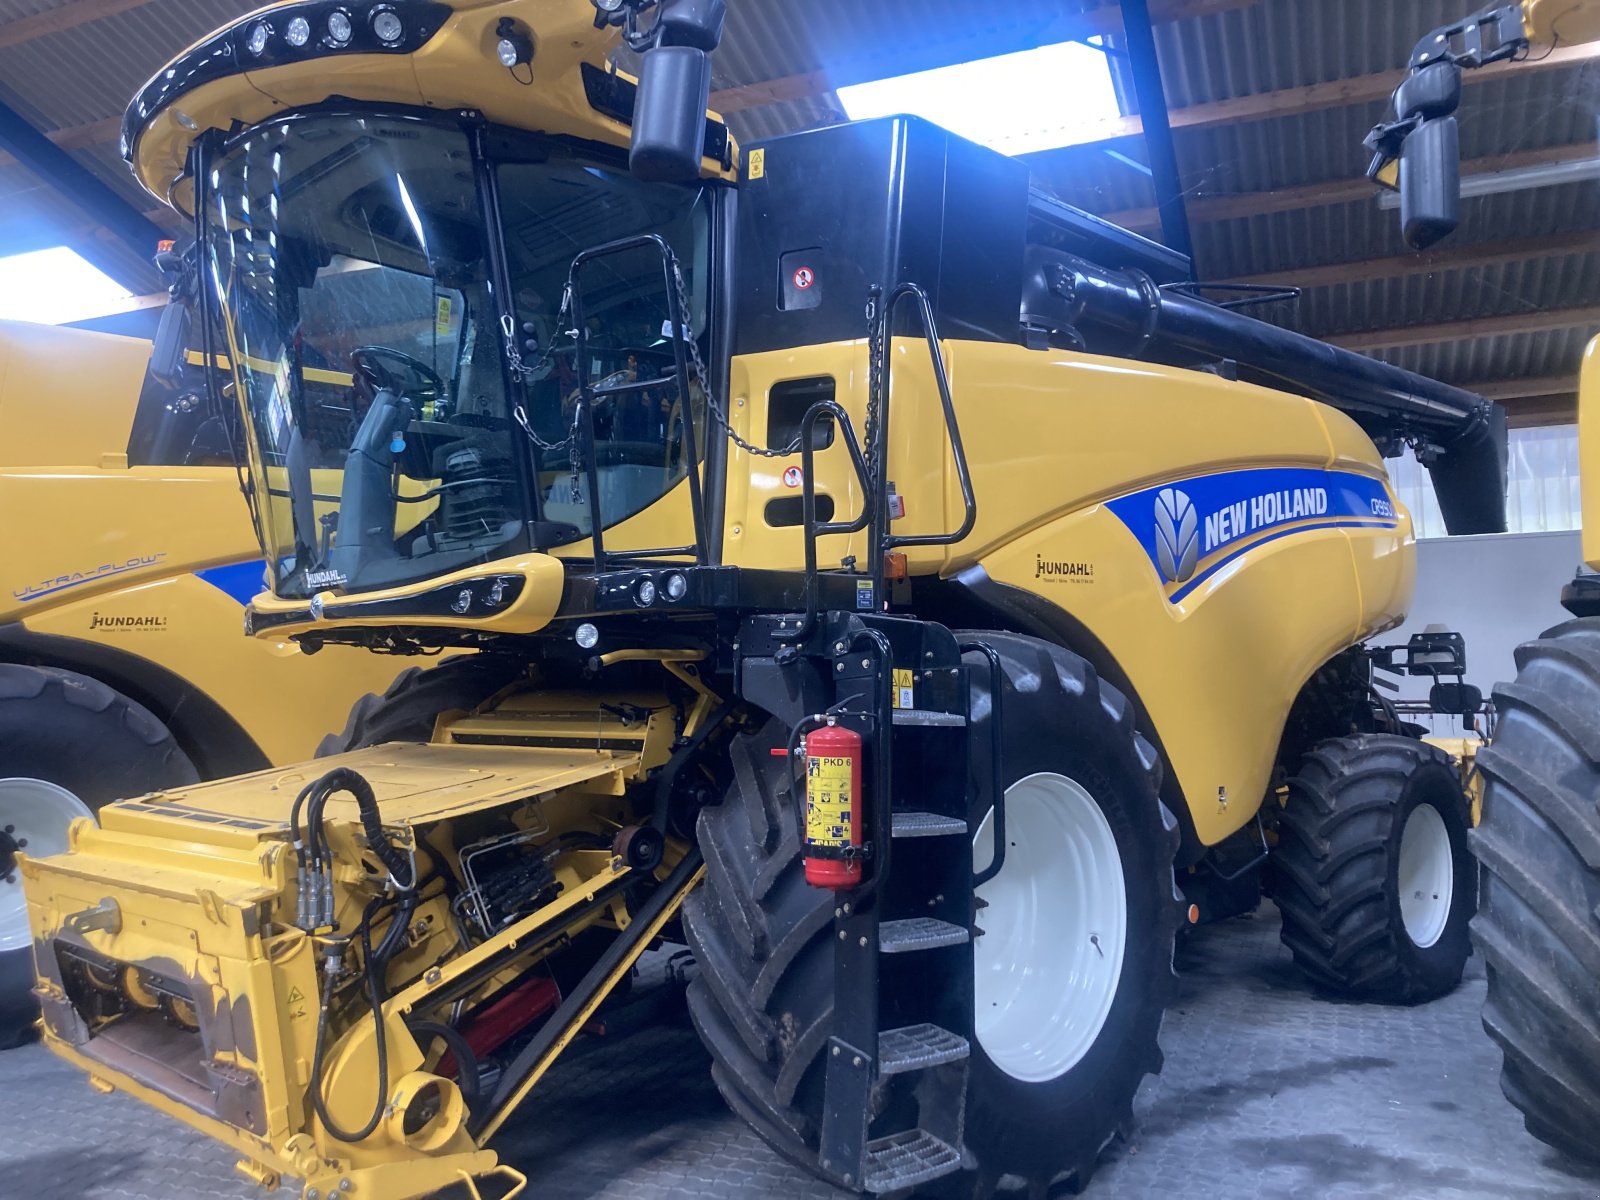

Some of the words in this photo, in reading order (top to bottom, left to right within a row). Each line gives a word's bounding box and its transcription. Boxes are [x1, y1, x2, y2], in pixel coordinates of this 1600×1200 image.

[1205, 500, 1247, 552] NEW
[1251, 488, 1327, 529] HOLLAND
[823, 758, 844, 767] PKD
[846, 758, 852, 767] 6
